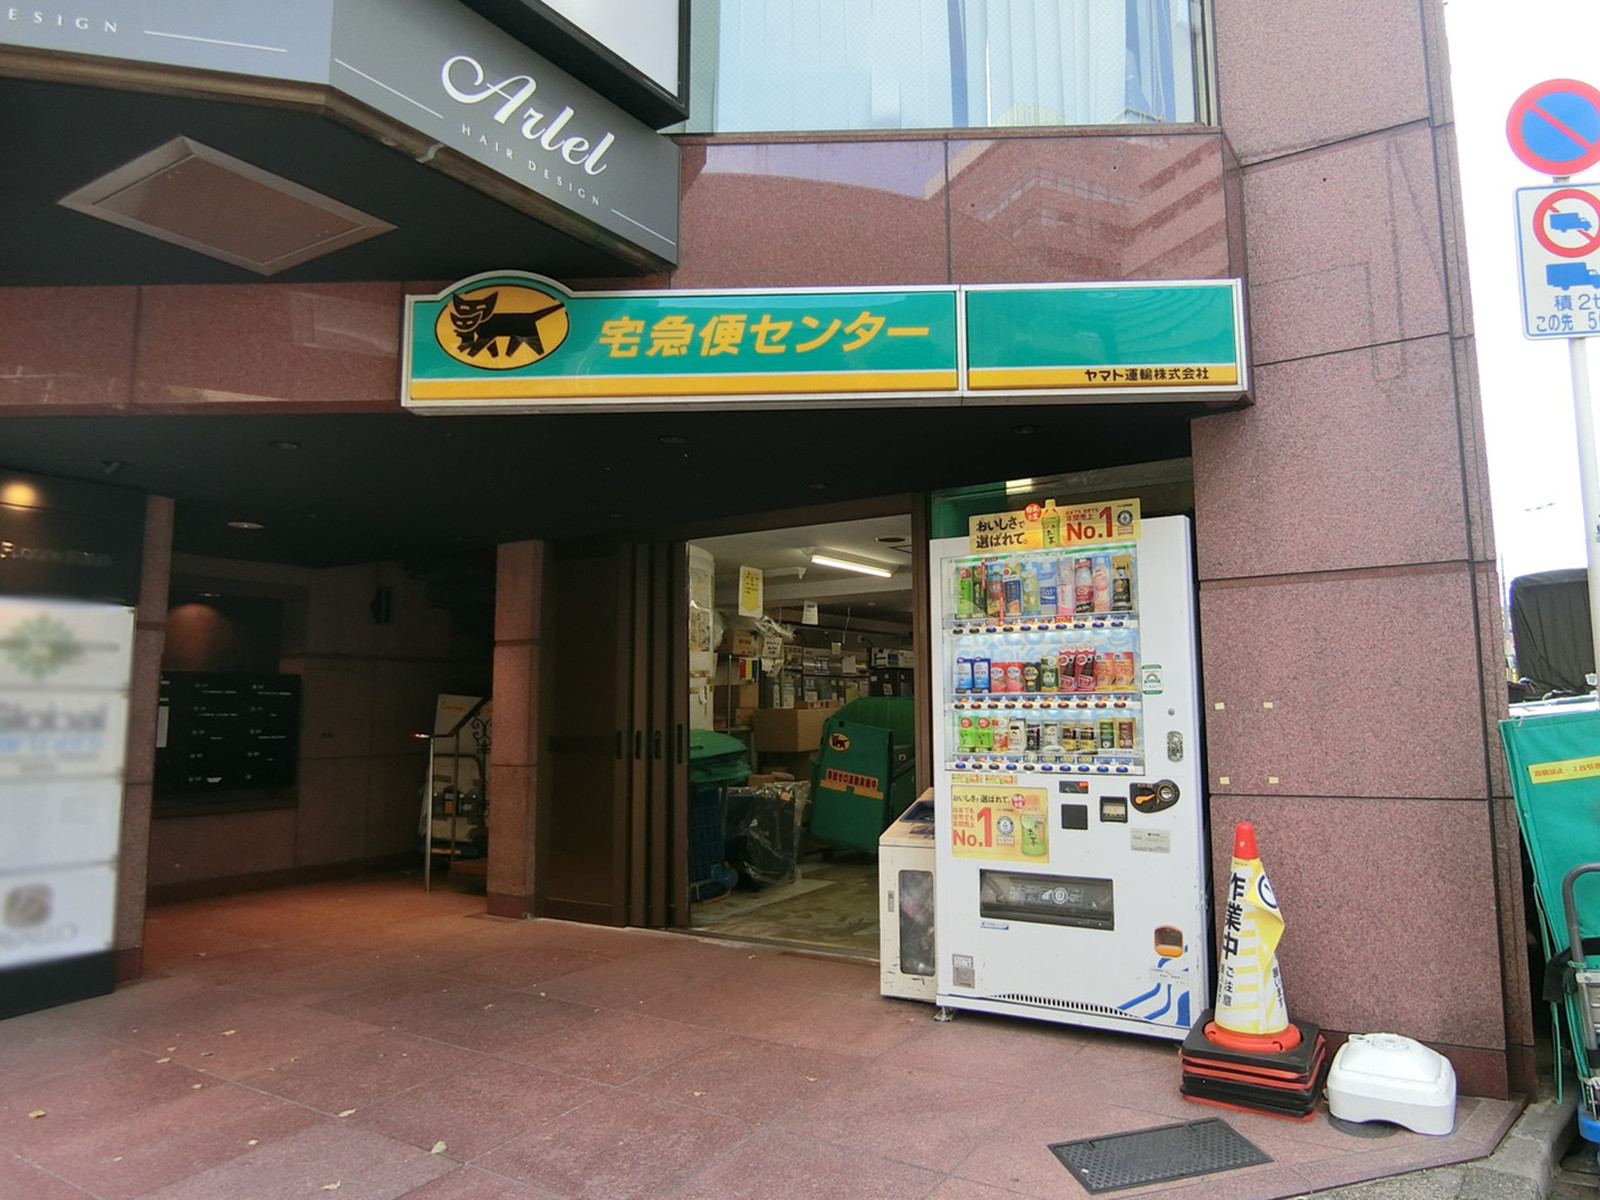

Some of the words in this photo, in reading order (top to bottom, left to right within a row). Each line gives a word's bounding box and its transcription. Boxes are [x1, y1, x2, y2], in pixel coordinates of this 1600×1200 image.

[441, 55, 615, 176] Arlel
[461, 123, 514, 161] HAIR
[527, 159, 600, 207] DESIGN
[598, 310, 930, 359] 宅急便センター
[1536, 313, 1574, 332] この先
[1084, 366, 1209, 383] ヤマト運輸株式会社
[977, 517, 1025, 533] おいしさで
[1066, 506, 1113, 541] No.1
[953, 807, 993, 847] No.1
